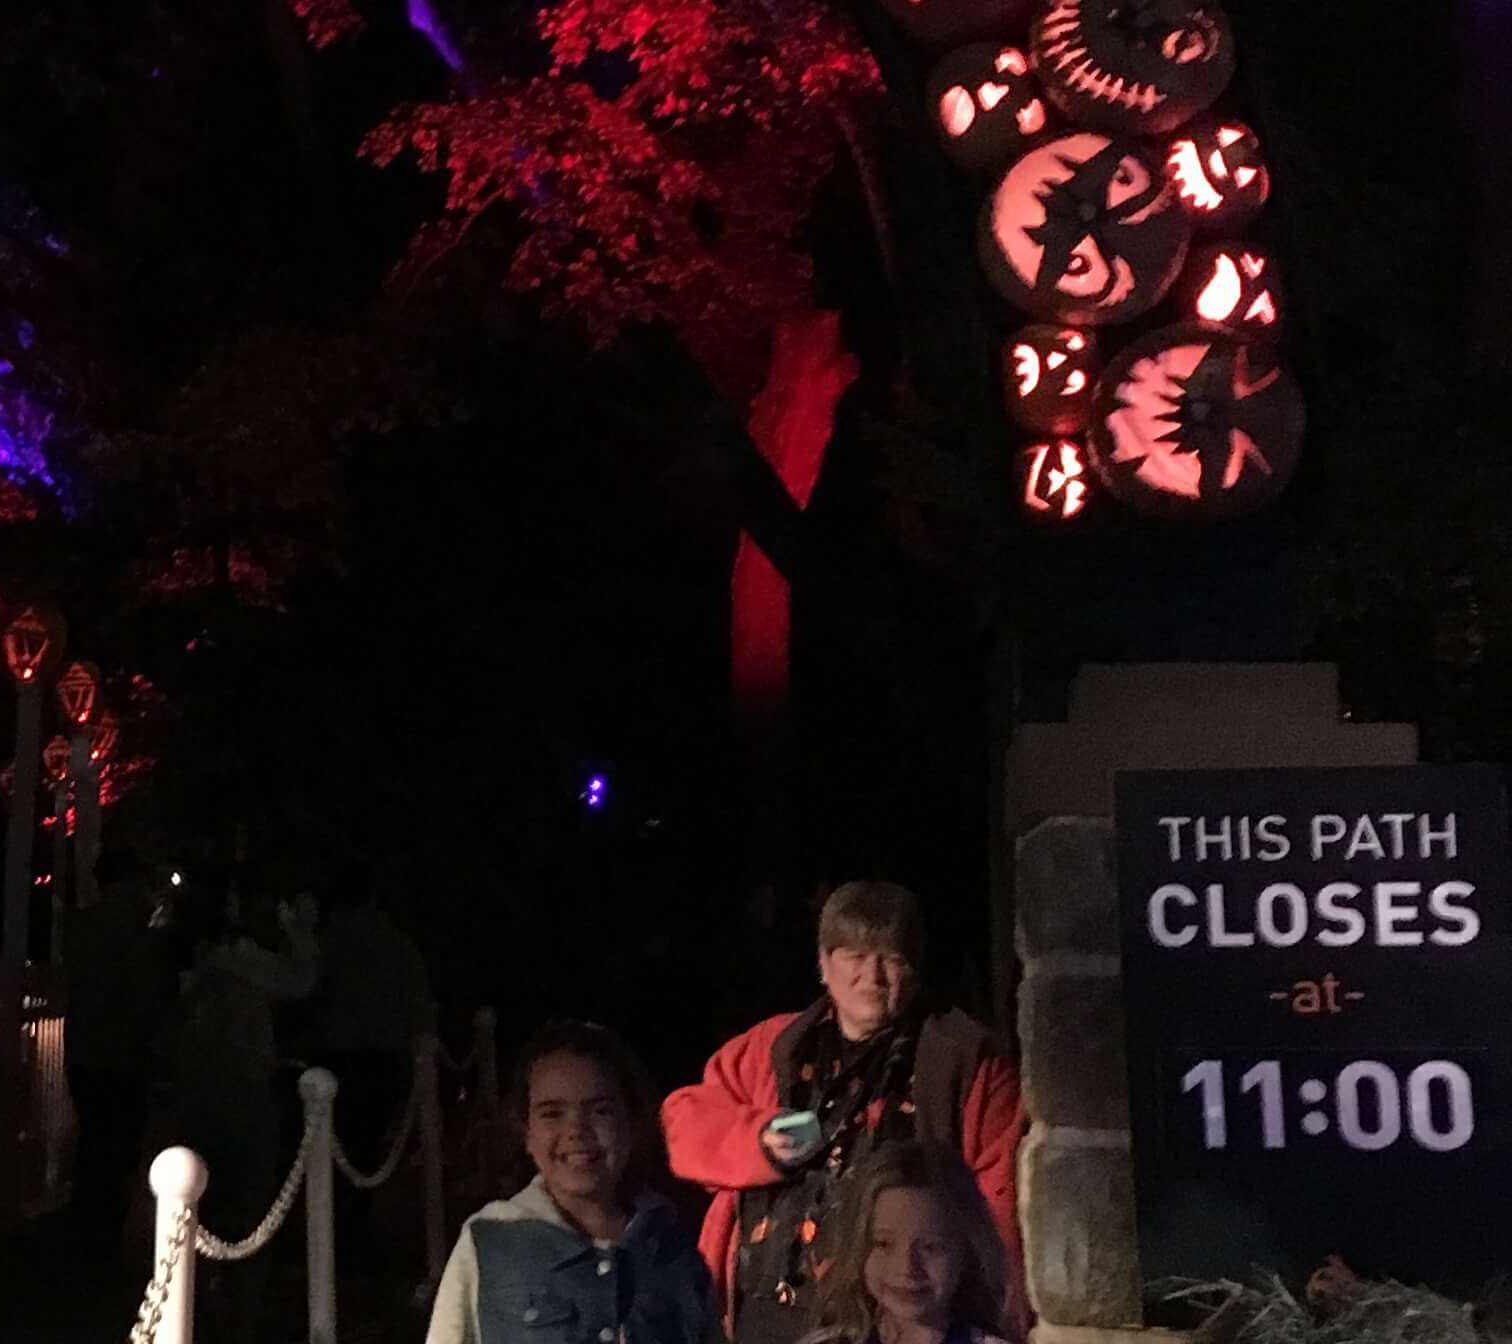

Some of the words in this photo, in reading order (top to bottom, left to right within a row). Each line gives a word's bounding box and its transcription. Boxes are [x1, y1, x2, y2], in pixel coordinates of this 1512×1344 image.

[1157, 815, 1291, 863] THIS
[1309, 811, 1459, 861] PATH
[1145, 880, 1481, 949] CLOSES
[1180, 1058, 1476, 1153] 11:00
